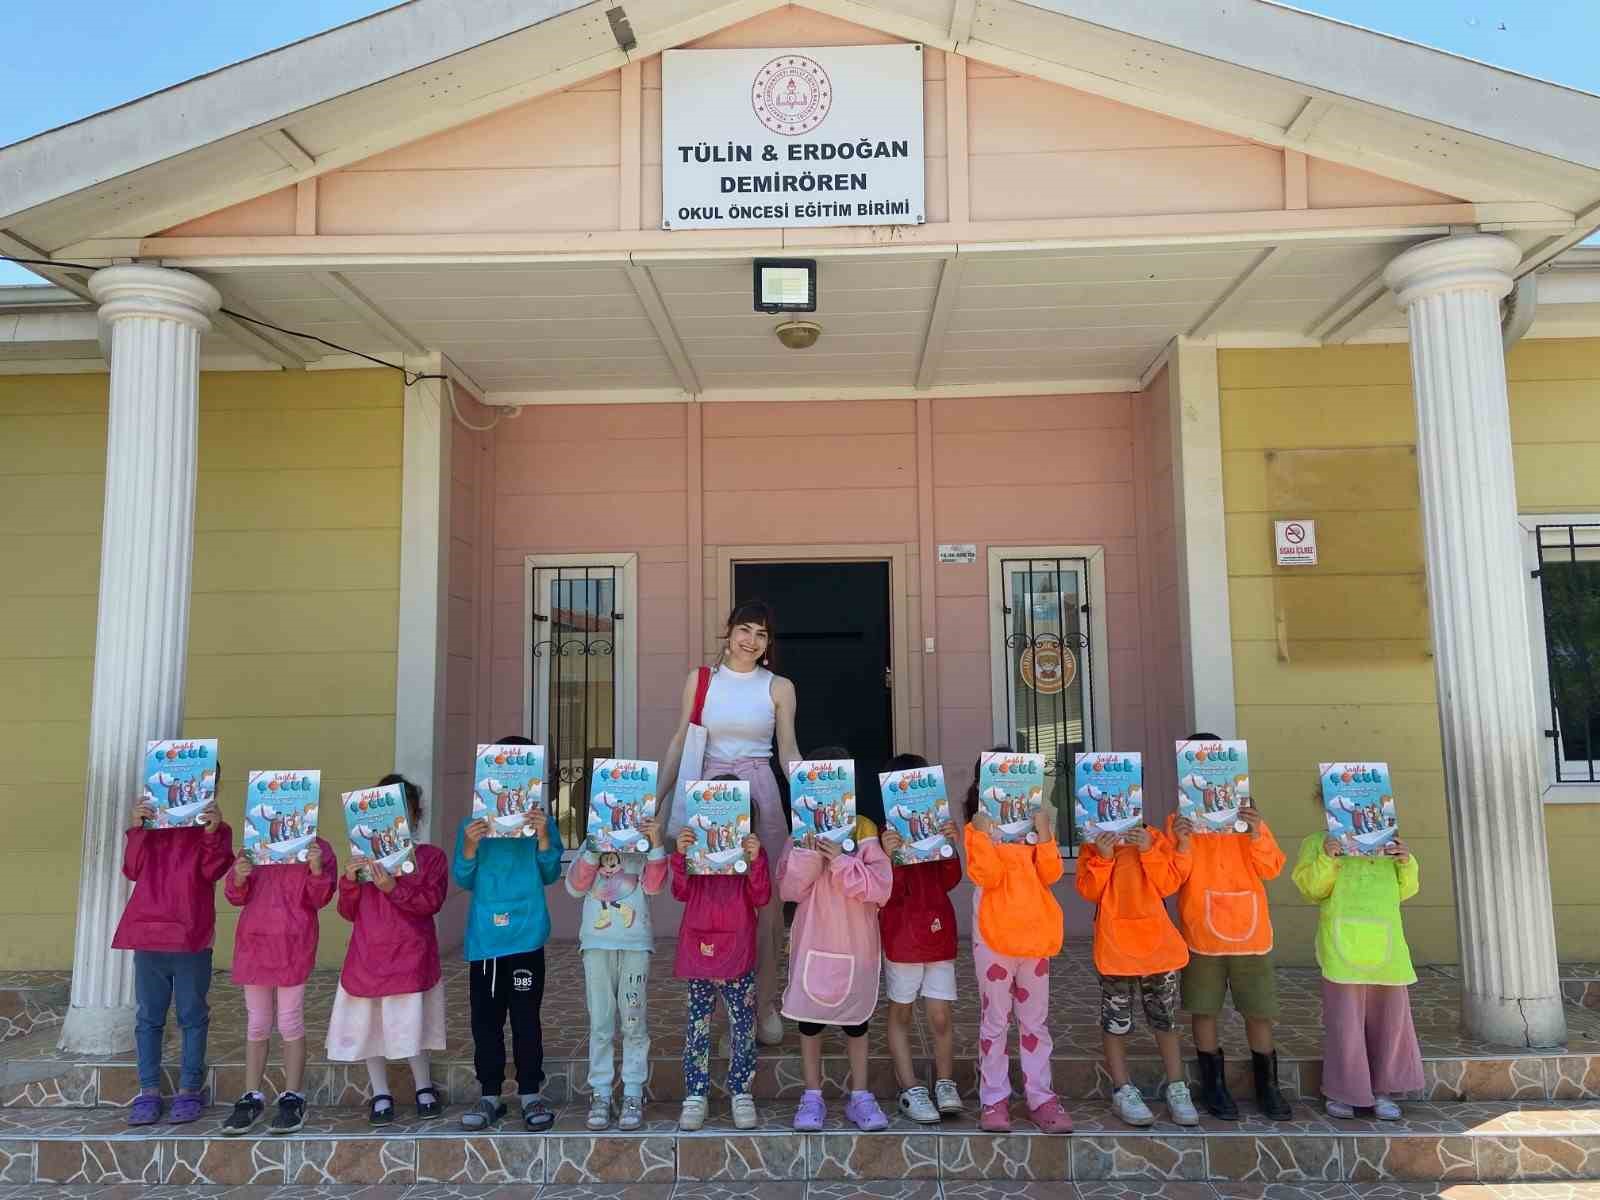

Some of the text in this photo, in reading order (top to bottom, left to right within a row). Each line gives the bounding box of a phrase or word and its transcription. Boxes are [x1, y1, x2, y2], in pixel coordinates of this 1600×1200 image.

[678, 138, 908, 162] TÜLİN & ERDOĞAN
[720, 171, 867, 193] DEMİRÖREN
[678, 199, 909, 220] OKUL ÖNCESİ EĞİTİM BİRİMİ
[513, 977, 532, 986] 1985
